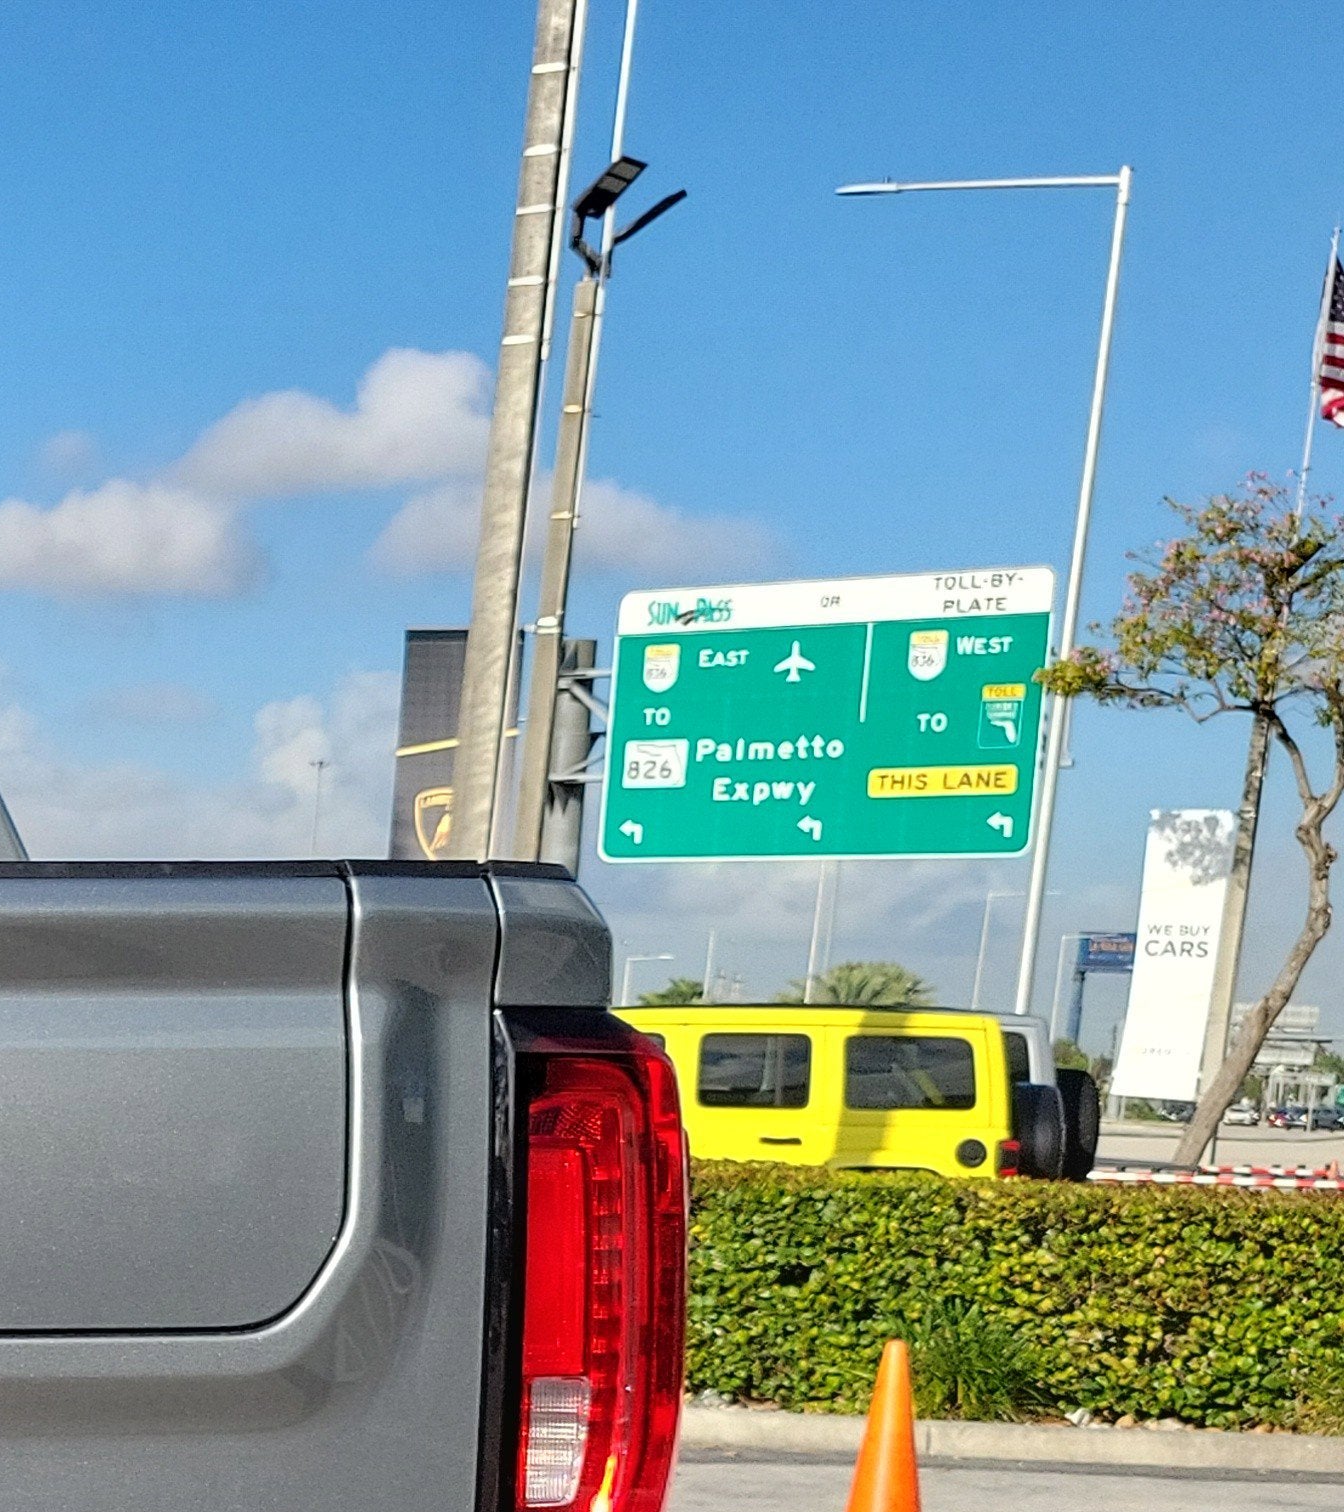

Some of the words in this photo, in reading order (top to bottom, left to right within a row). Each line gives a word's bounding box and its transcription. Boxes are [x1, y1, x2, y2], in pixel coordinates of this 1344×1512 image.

[934, 572, 1024, 591] TOLL-BY-
[820, 595, 841, 608] OR
[942, 597, 1008, 613] PLATE
[957, 636, 1013, 655] WEST
[698, 648, 750, 668] EAST
[643, 707, 672, 726] TO
[917, 712, 948, 733] TO
[695, 734, 845, 762] Palmetto
[627, 760, 673, 780] 826
[876, 773, 928, 791] THIS
[942, 770, 1009, 790] LANE
[713, 777, 816, 806] Expwy
[1147, 924, 1174, 936] WE
[1179, 924, 1210, 936] BUY
[1145, 940, 1209, 958] CARS
